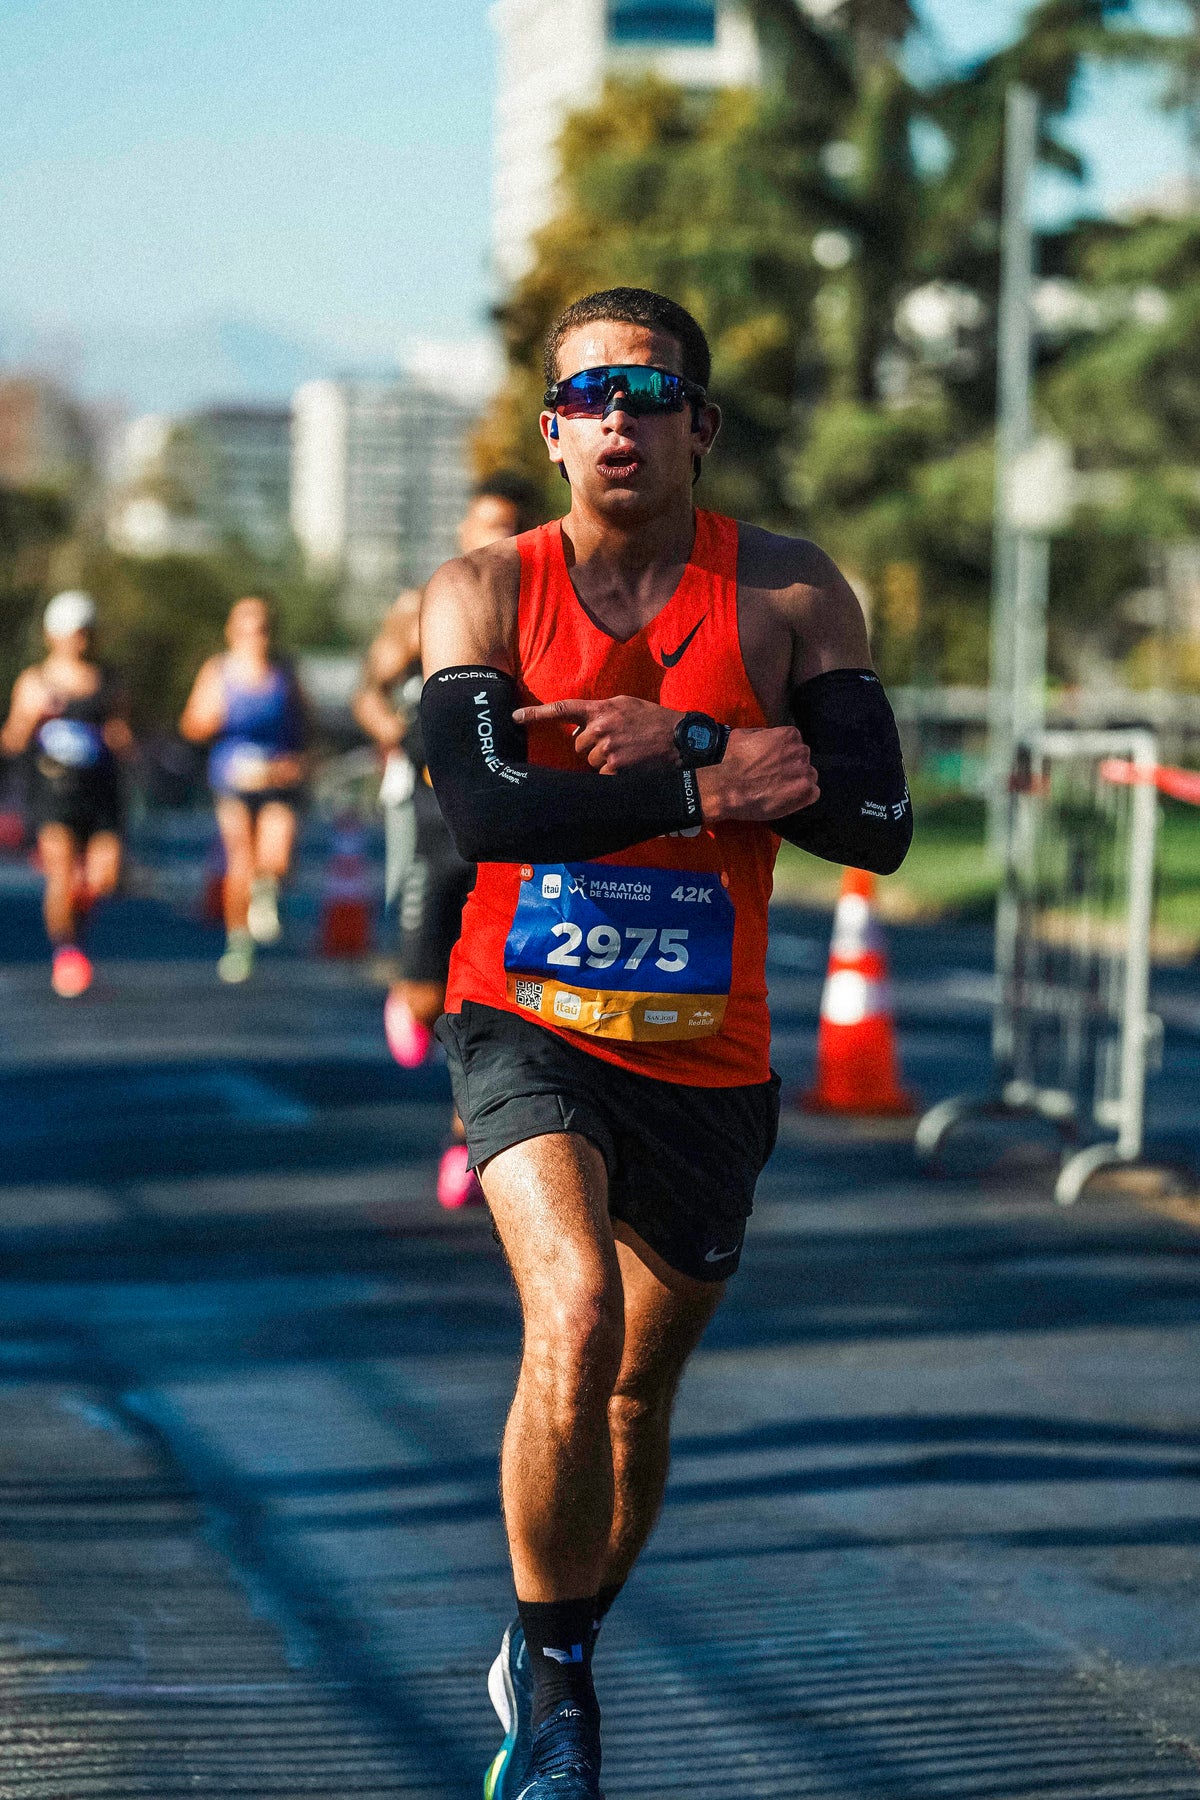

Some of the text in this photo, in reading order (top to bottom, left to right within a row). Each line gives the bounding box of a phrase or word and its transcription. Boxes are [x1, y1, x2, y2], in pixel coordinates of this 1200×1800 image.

[449, 671, 498, 680] VORNE
[477, 709, 504, 773] VORNE
[503, 766, 528, 779] Forward.
[683, 770, 695, 805] VORNE
[544, 884, 559, 894] itaú
[590, 880, 652, 894] MARATÓN
[589, 889, 652, 901] DE SANTIAGO
[671, 886, 714, 903] 42K
[546, 922, 689, 973] 2975
[556, 1001, 578, 1015] itaú
